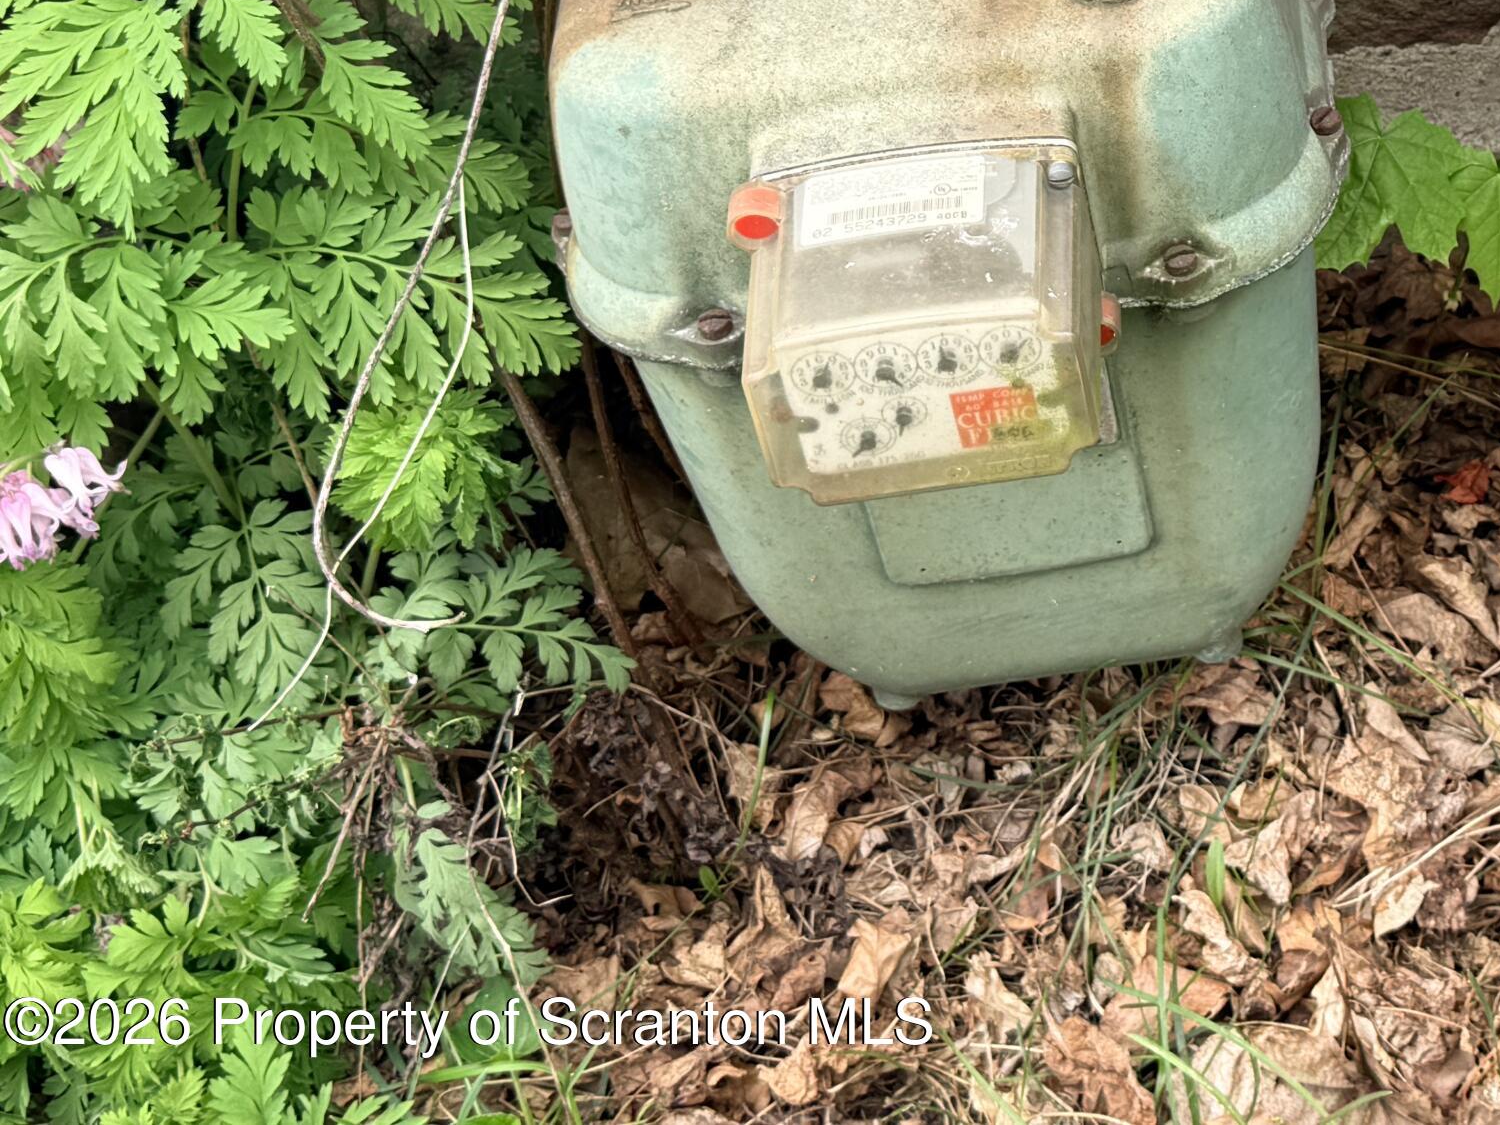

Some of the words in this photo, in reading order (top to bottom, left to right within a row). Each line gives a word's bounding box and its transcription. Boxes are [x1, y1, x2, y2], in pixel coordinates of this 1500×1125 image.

[812, 227, 833, 239] 02
[844, 212, 927, 234] 55243729
[956, 392, 985, 403] TEMP
[958, 405, 1035, 428] CUBIC
